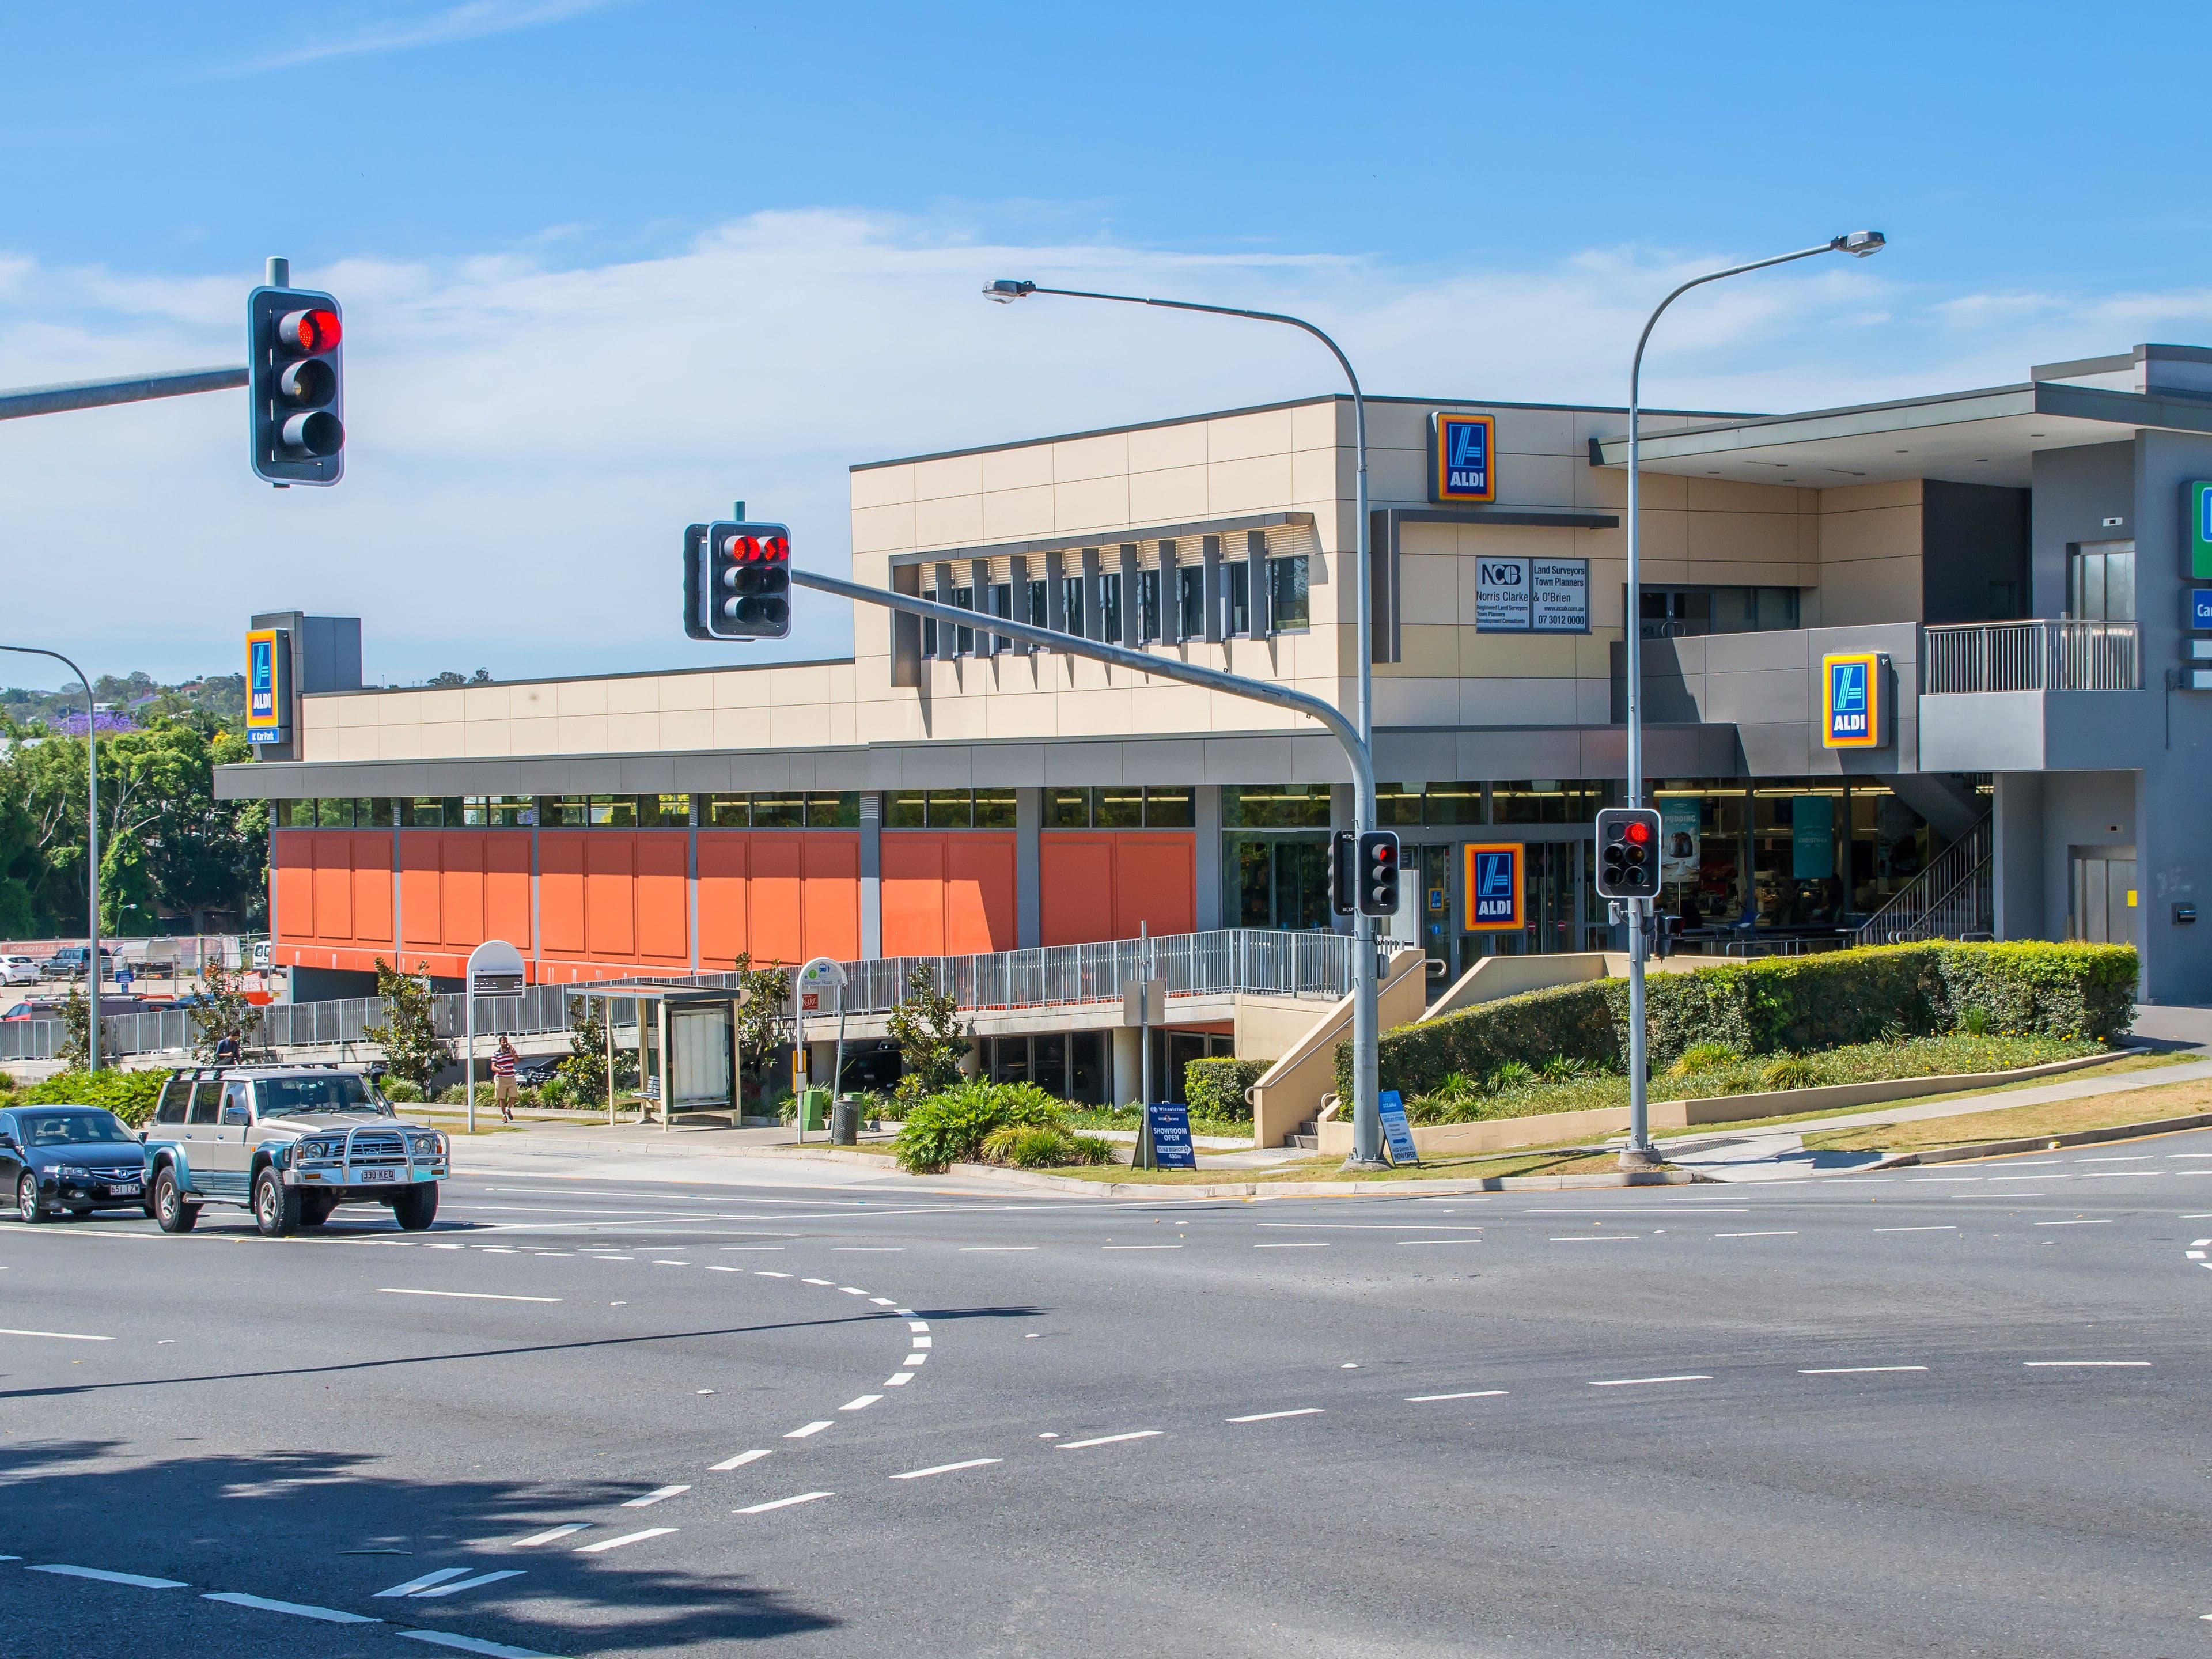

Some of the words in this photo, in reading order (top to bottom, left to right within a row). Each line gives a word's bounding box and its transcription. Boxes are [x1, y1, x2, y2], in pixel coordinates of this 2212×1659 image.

[1450, 471, 1484, 487] ALDI
[1534, 565, 1550, 574] Land
[1552, 566, 1585, 576] Surveyors
[1535, 577, 1554, 586] Town
[1555, 578, 1584, 586] Planners
[1476, 591, 1500, 601] Norris
[1502, 591, 1528, 601] Clarke
[1533, 592, 1540, 602] &
[1542, 592, 1571, 602] O'Brien
[1538, 615, 1547, 624] 07
[1548, 615, 1566, 624] 3012
[1567, 616, 1584, 624] 0000
[253, 693, 271, 709] ALDI
[1834, 714, 1865, 731] ALDI
[264, 731, 274, 741] Park
[1665, 815, 1696, 823] PUDDING
[1478, 900, 1512, 915] ALDI
